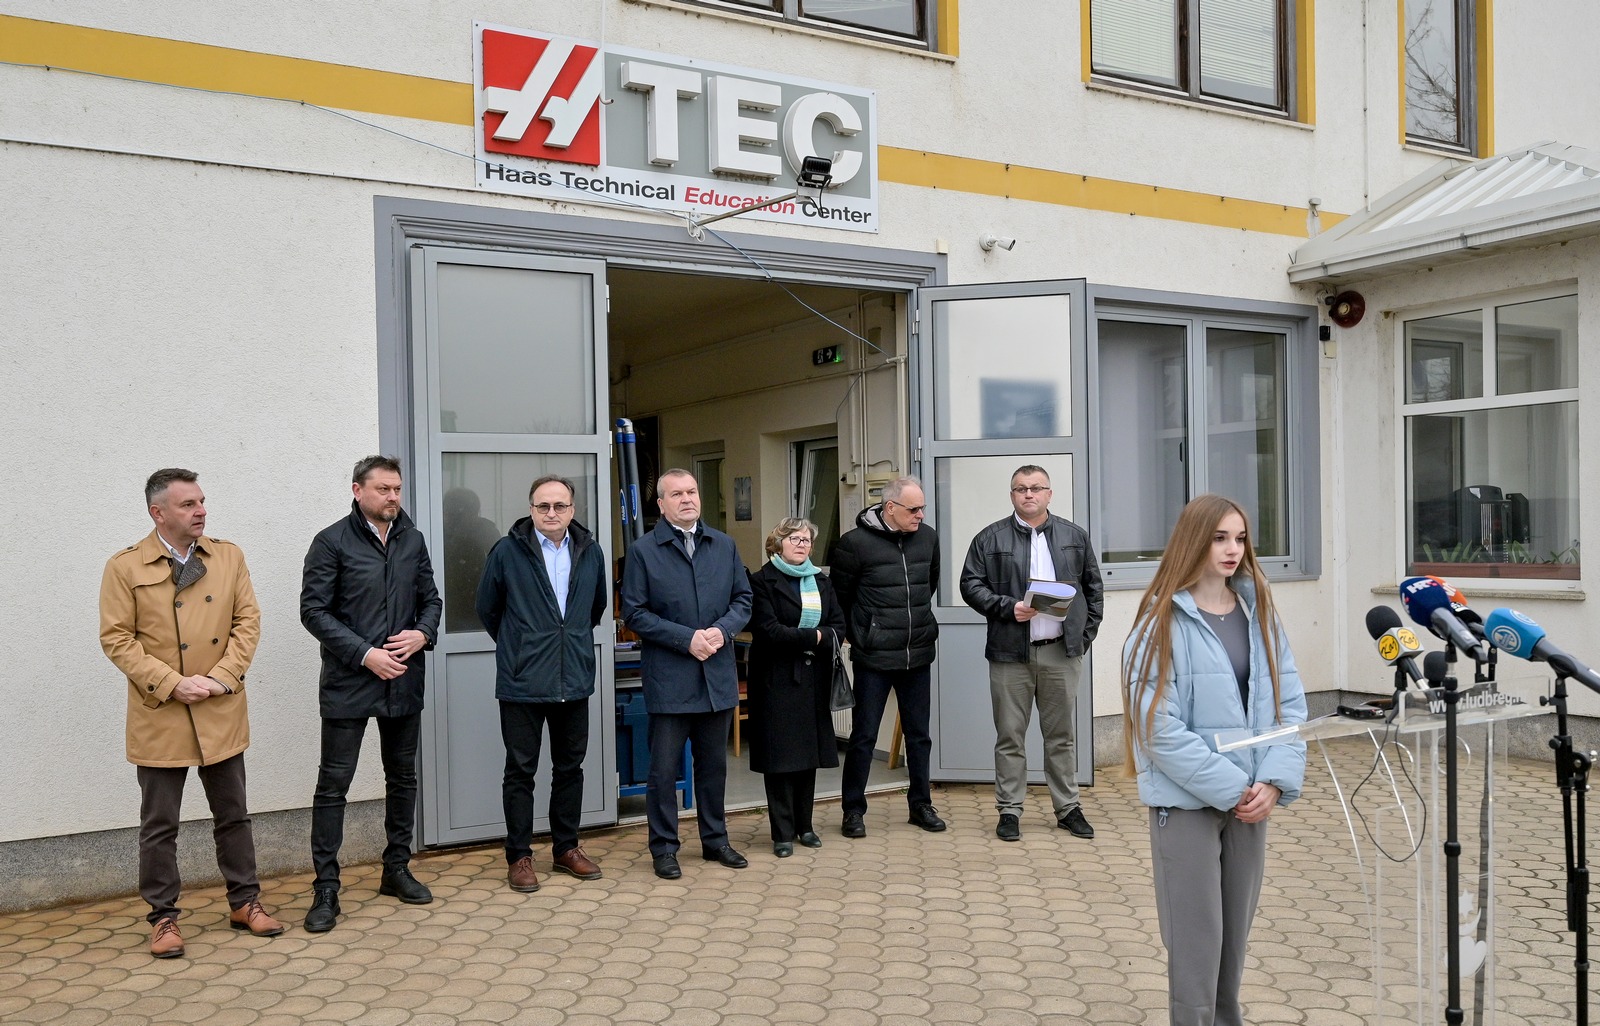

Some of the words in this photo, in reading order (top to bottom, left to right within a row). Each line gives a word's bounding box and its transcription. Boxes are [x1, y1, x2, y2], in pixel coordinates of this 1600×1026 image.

[485, 162, 552, 187] Haas
[559, 170, 675, 201] Technical
[684, 186, 796, 215] Education
[801, 201, 872, 224] Center
